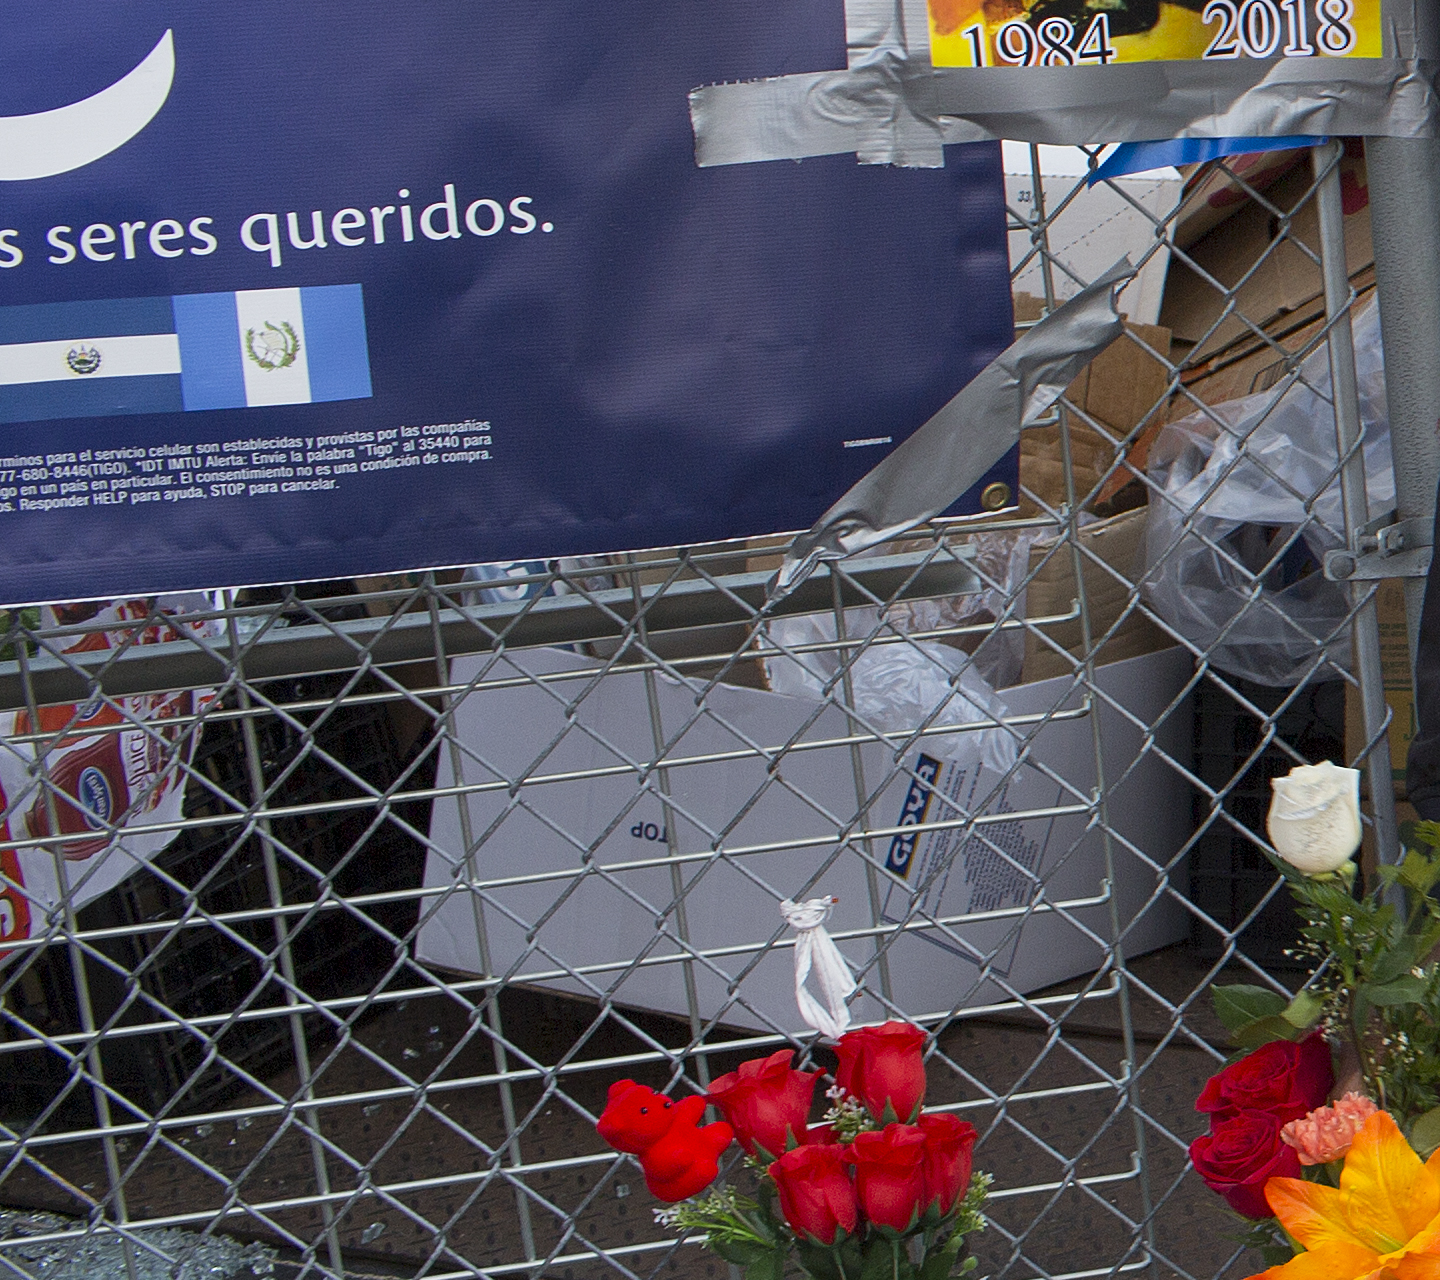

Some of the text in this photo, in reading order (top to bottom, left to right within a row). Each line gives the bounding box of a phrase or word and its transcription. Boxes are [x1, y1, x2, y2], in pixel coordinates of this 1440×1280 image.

[962, 12, 1117, 67] 1984
[46, 211, 219, 265] seres
[240, 182, 555, 268] queridos.
[44, 452, 77, 466] para
[78, 449, 93, 461] el
[91, 445, 146, 460] servicio
[146, 442, 193, 456] celular
[195, 442, 220, 452] son
[221, 436, 303, 450] establecidas
[304, 435, 313, 447] y
[315, 428, 375, 446] provistas
[376, 428, 398, 441] por
[399, 424, 421, 437] las
[419, 419, 491, 438] compañías
[167, 456, 201, 470] IMTU
[204, 453, 248, 467] Alerta:
[251, 450, 287, 463] Envíe
[289, 449, 303, 461] la
[306, 445, 355, 462] palabra
[357, 442, 398, 458] "Tigo"
[400, 440, 415, 452] al
[417, 437, 460, 451] 35440
[461, 437, 492, 450] para
[18, 451, 492, 496] en un país en particular. El consentimiento no es una condición de compra.
[18, 478, 339, 511] Responder HELP para ayuda, STOP para cancelar.
[890, 763, 936, 868] GOYA
